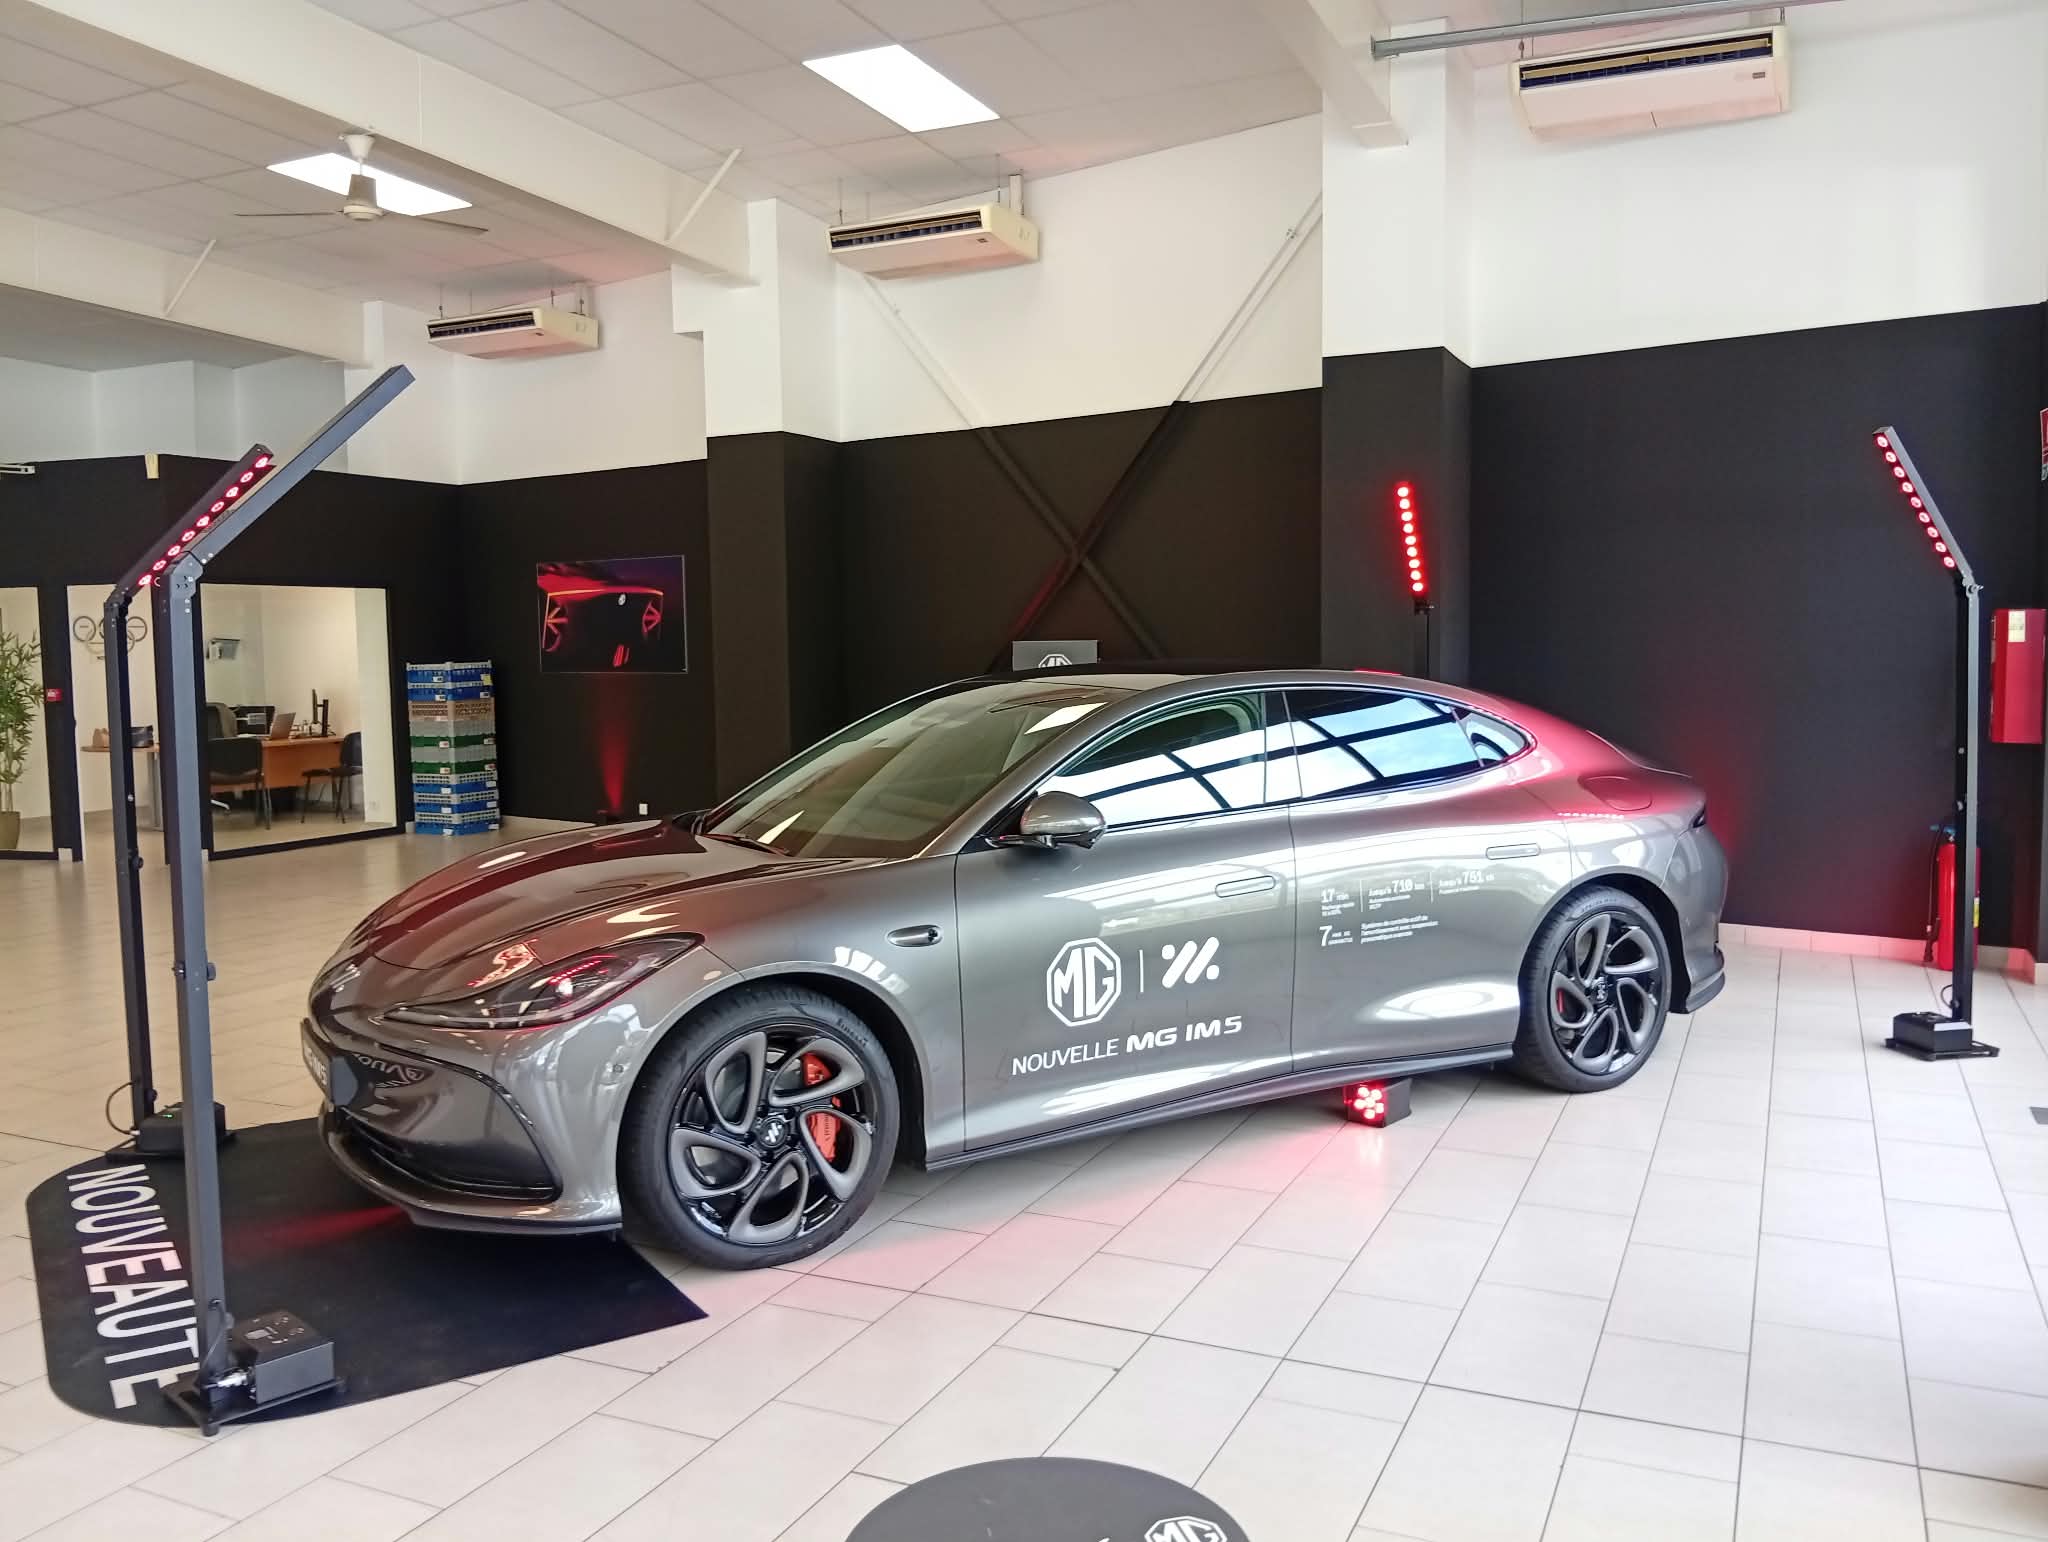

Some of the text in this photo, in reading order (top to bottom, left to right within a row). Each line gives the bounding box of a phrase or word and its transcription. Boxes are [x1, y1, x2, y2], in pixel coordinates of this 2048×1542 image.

[1321, 888, 1335, 903] 17
[1319, 925, 1333, 946] 7
[1050, 943, 1118, 1022] MG
[1012, 1015, 1243, 1075] NOUVELLE MG IM5
[1149, 1518, 1225, 1542] MG
